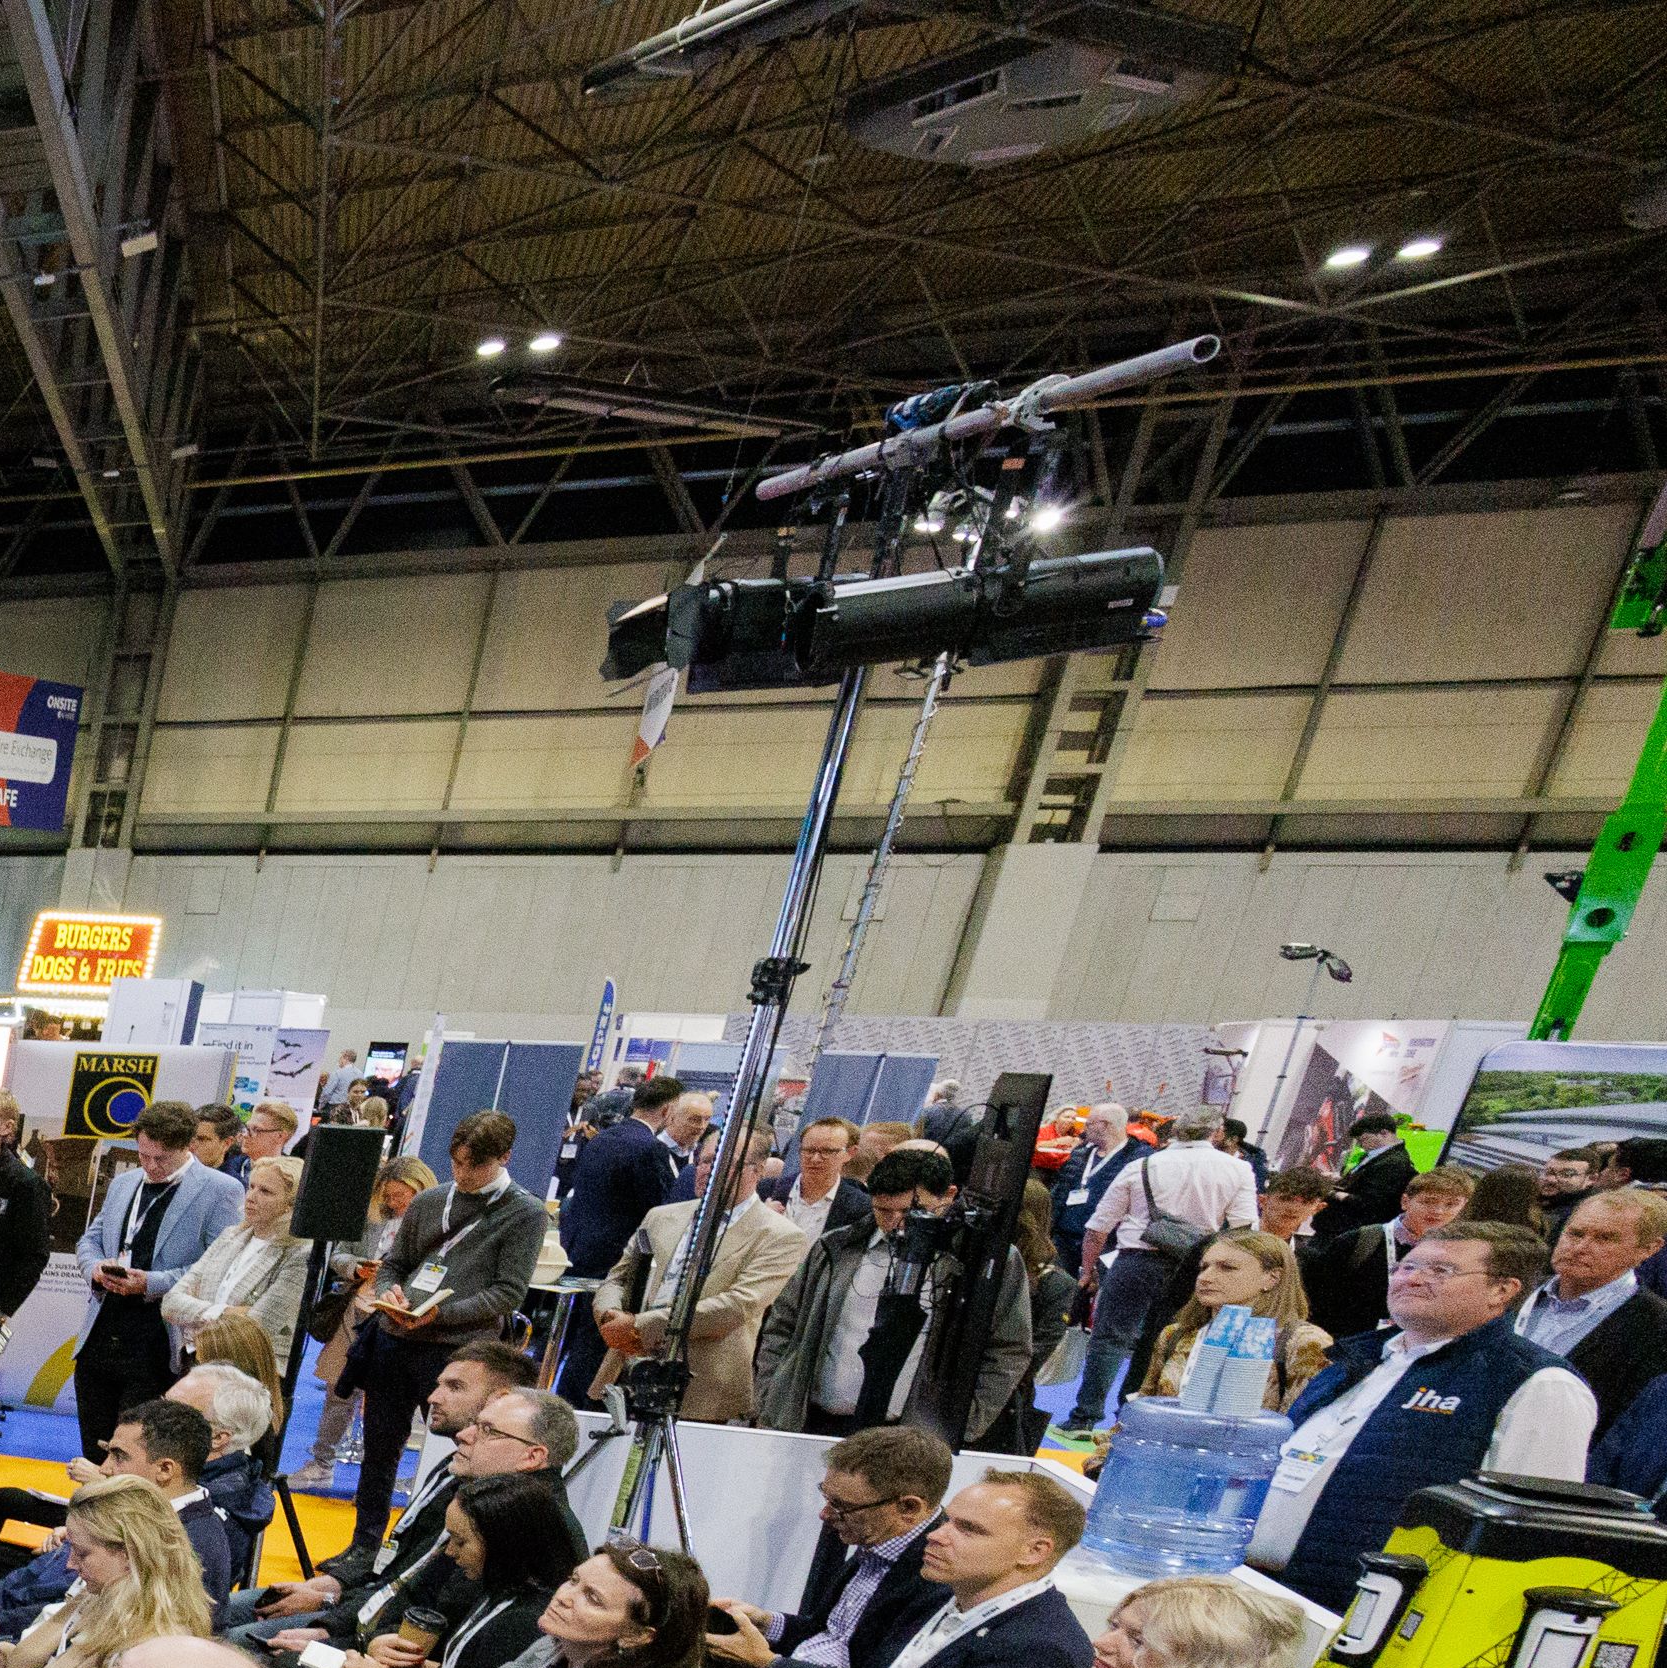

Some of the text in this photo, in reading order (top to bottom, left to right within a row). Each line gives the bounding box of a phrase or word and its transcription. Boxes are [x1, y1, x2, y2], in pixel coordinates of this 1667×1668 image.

[47, 695, 79, 712] ONSITE
[11, 740, 53, 765] Exchange
[54, 922, 133, 952] BURGERS
[30, 954, 76, 982] DOGS
[78, 957, 91, 982] &
[78, 1056, 154, 1074] MARSH
[1401, 1386, 1461, 1411] jha
